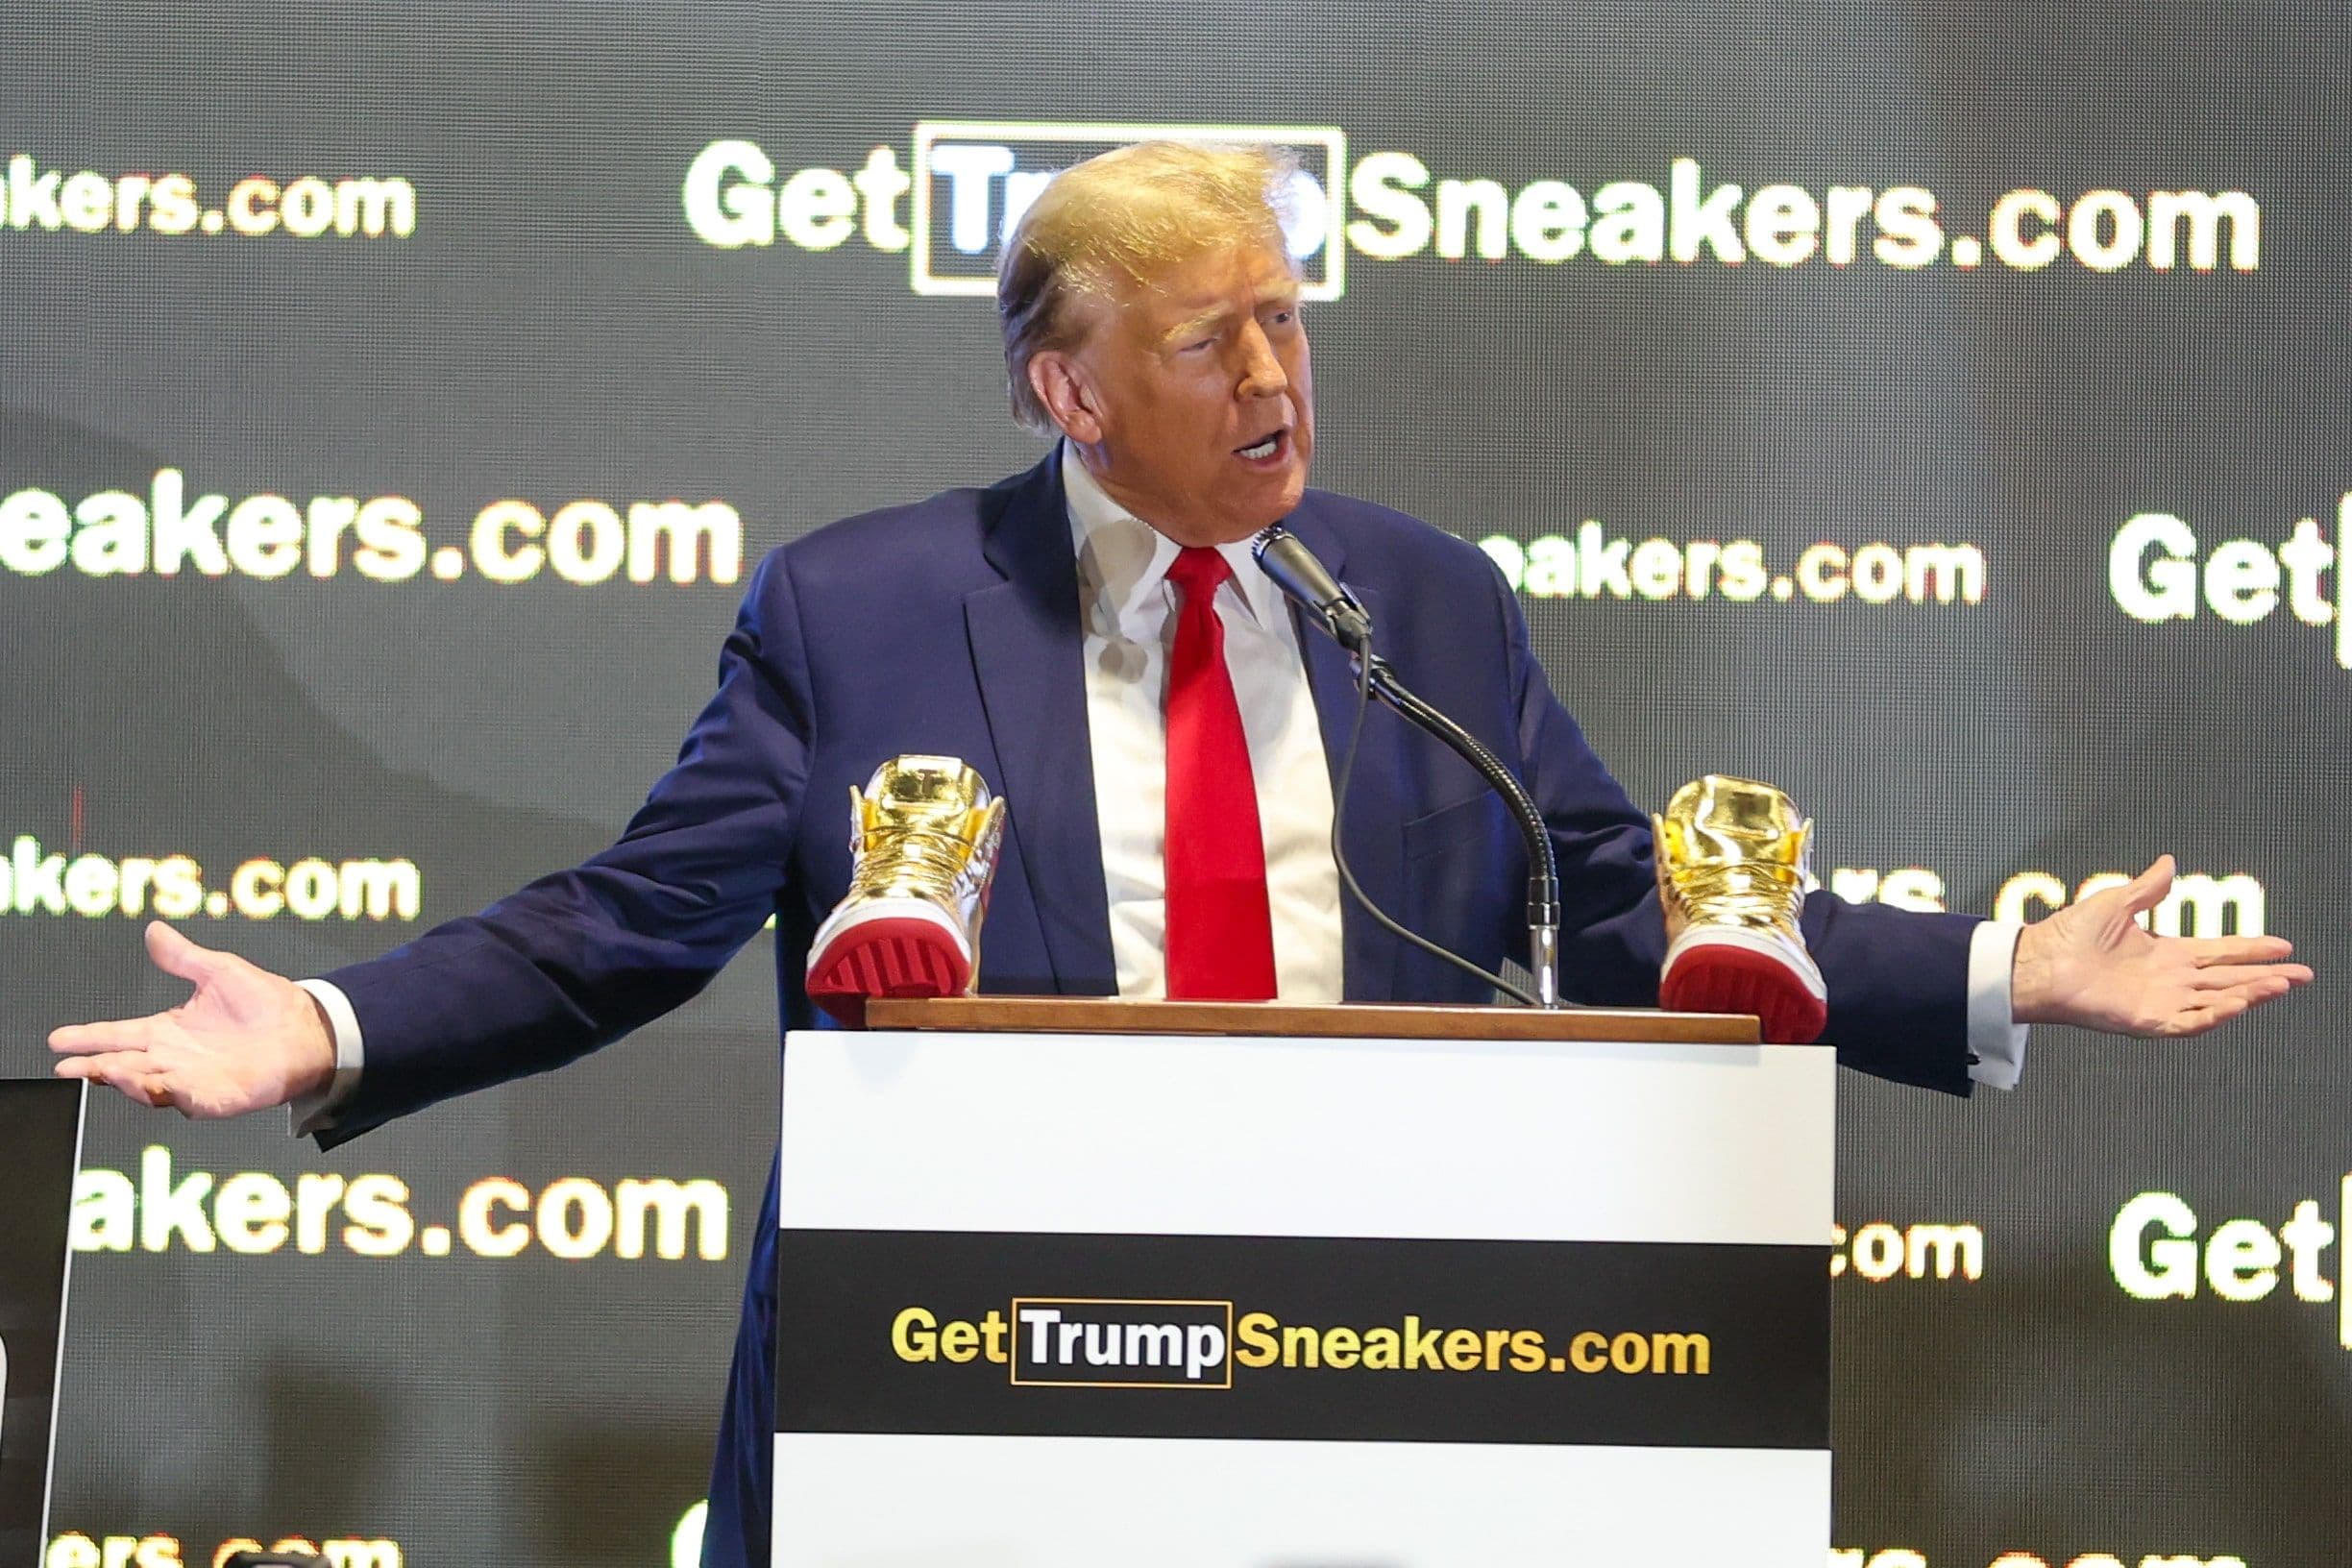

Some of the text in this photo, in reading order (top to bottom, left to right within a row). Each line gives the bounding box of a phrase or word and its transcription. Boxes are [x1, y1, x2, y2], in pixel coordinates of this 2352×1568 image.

[0, 154, 416, 238] kers.com
[0, 468, 744, 586] eakers.com
[0, 835, 420, 919] kers.com
[71, 1143, 729, 1261] akers.com
